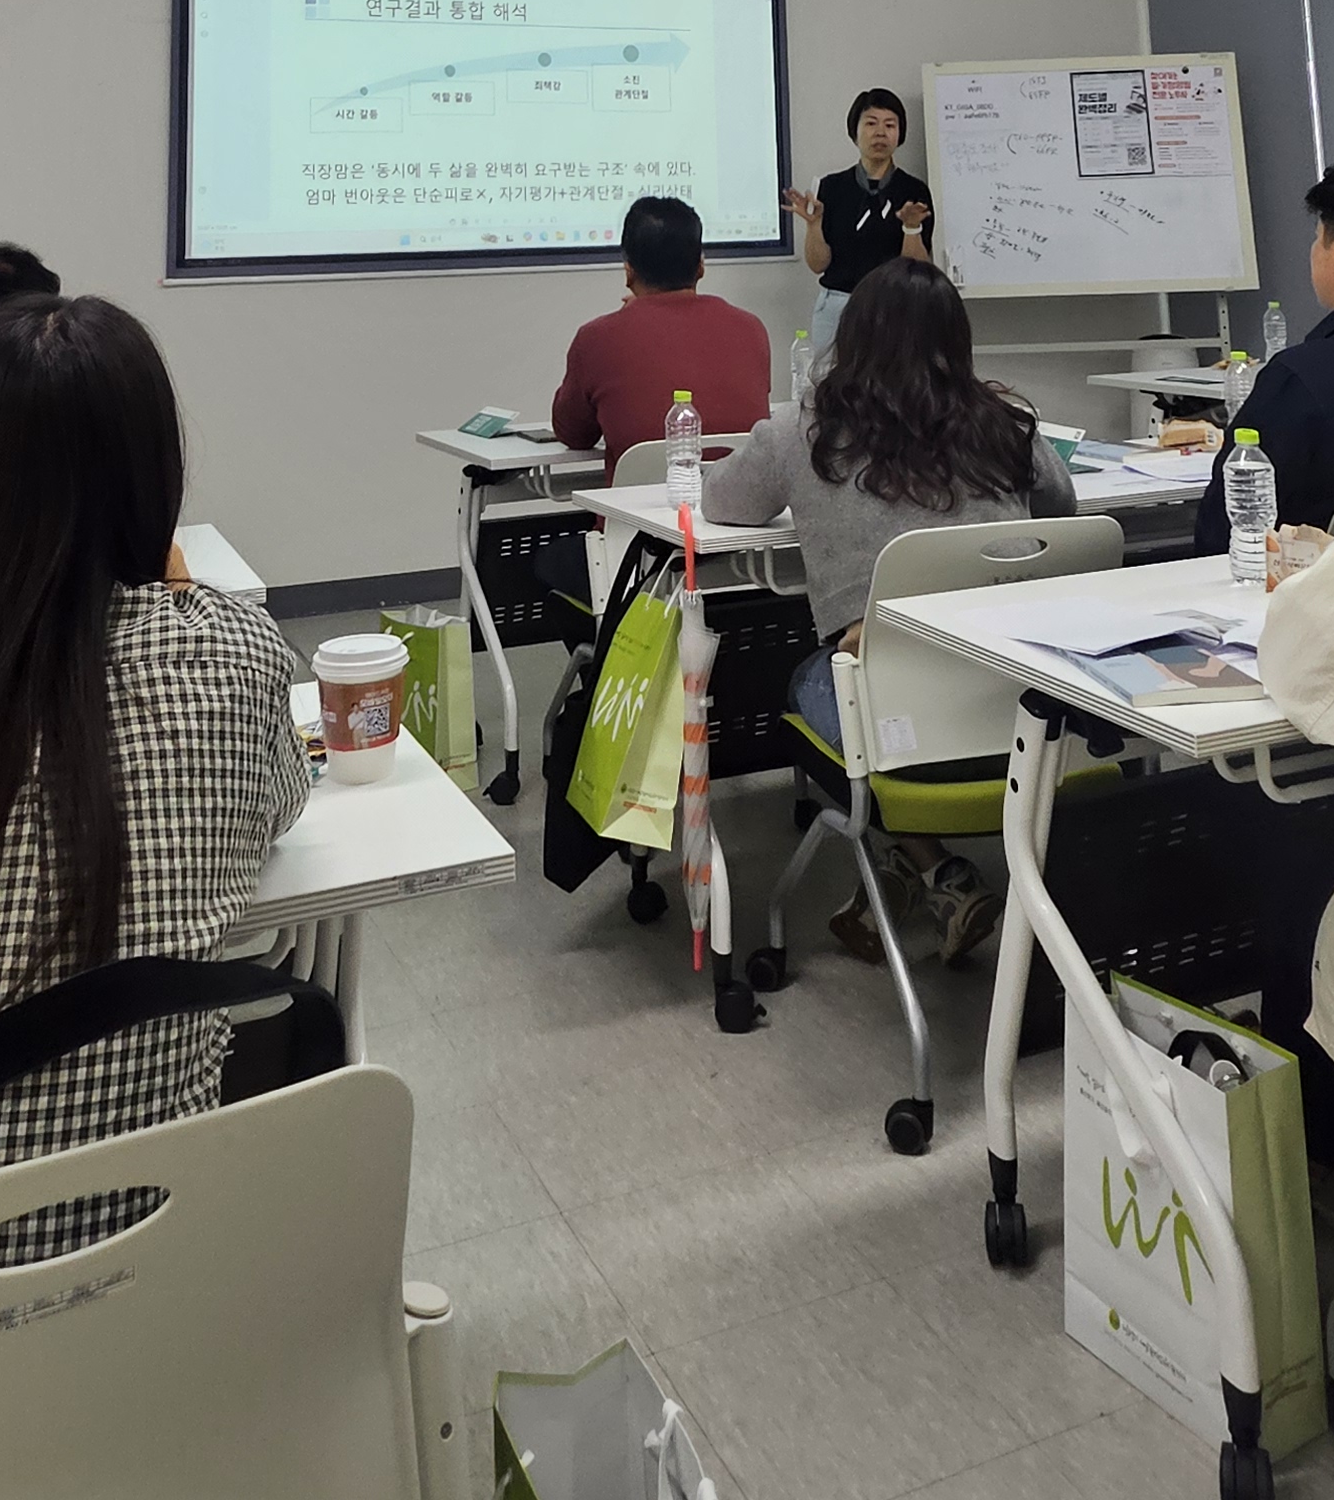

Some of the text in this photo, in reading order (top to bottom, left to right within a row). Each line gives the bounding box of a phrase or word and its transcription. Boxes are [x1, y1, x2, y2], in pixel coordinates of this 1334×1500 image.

[449, 0, 485, 21] 통합
[493, 1, 528, 22] 해석
[534, 80, 561, 91] 죄책감
[623, 75, 640, 85] 소진
[431, 92, 473, 103] 역할 갈등
[614, 89, 649, 100] 관계단절
[335, 108, 378, 120] 시간 갈등
[302, 163, 366, 180] 직장맘은
[428, 164, 443, 179] 두
[449, 162, 478, 179] 삶을
[485, 162, 528, 178] 완벽히
[534, 162, 591, 178] 요구받는
[633, 161, 660, 177] 속에
[666, 161, 697, 177] 있다.
[306, 188, 336, 206] 엄마
[344, 187, 407, 205] 번아웃은
[499, 185, 624, 202] 자기평가+관계단절
